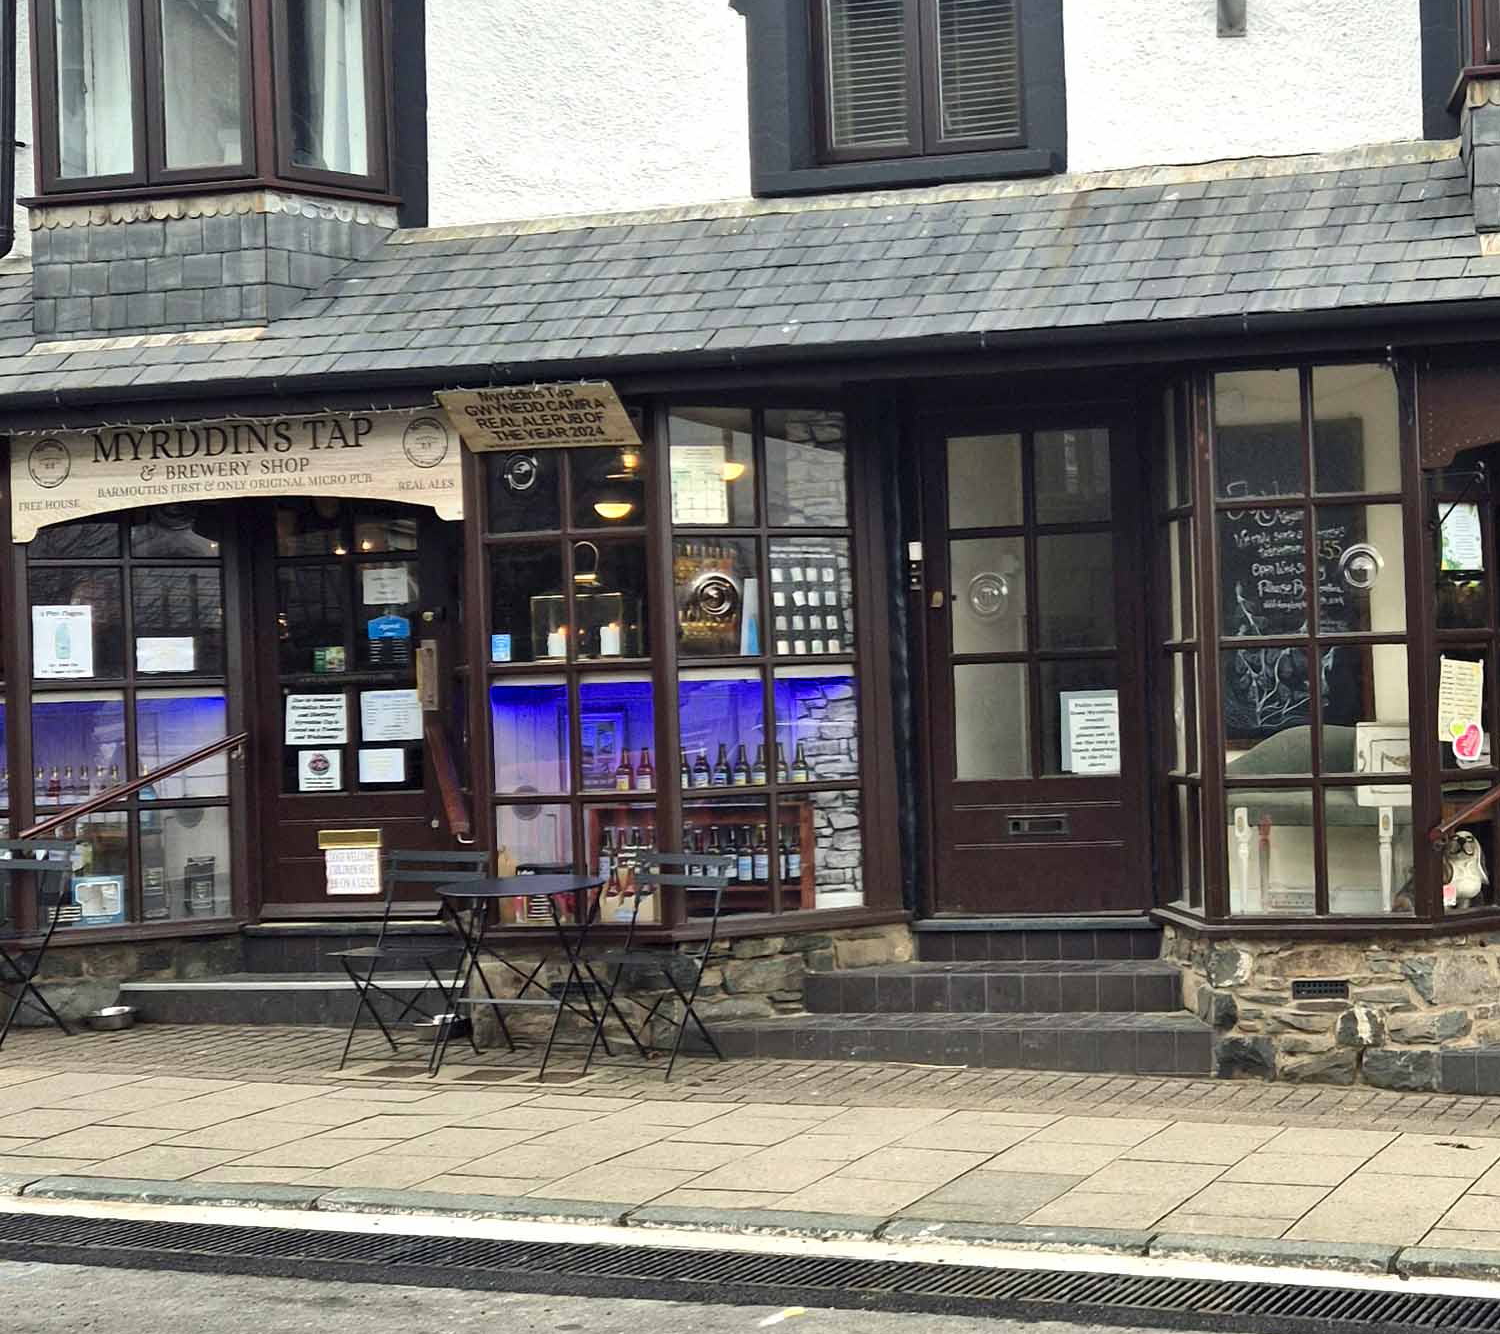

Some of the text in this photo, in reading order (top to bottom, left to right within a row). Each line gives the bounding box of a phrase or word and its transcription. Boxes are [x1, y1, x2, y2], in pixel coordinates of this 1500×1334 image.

[463, 397, 607, 417] GWYNEDD CAMRA
[475, 417, 522, 430] REAL
[585, 411, 605, 424] OF
[91, 420, 293, 463] MYRDDINS
[302, 417, 374, 450] TAP
[490, 426, 606, 442] THE YEAR 2024
[140, 456, 310, 481] & BREWERY SHOP
[97, 483, 168, 498] BARMOUTHS
[171, 481, 202, 494] FIRST
[216, 478, 249, 492] ONLY
[249, 477, 306, 489] ORIGINAL
[307, 475, 347, 487] MICRO
[349, 472, 374, 485] PUB
[398, 478, 455, 492] REAL ALES
[18, 498, 81, 512] FREE HOUSE
